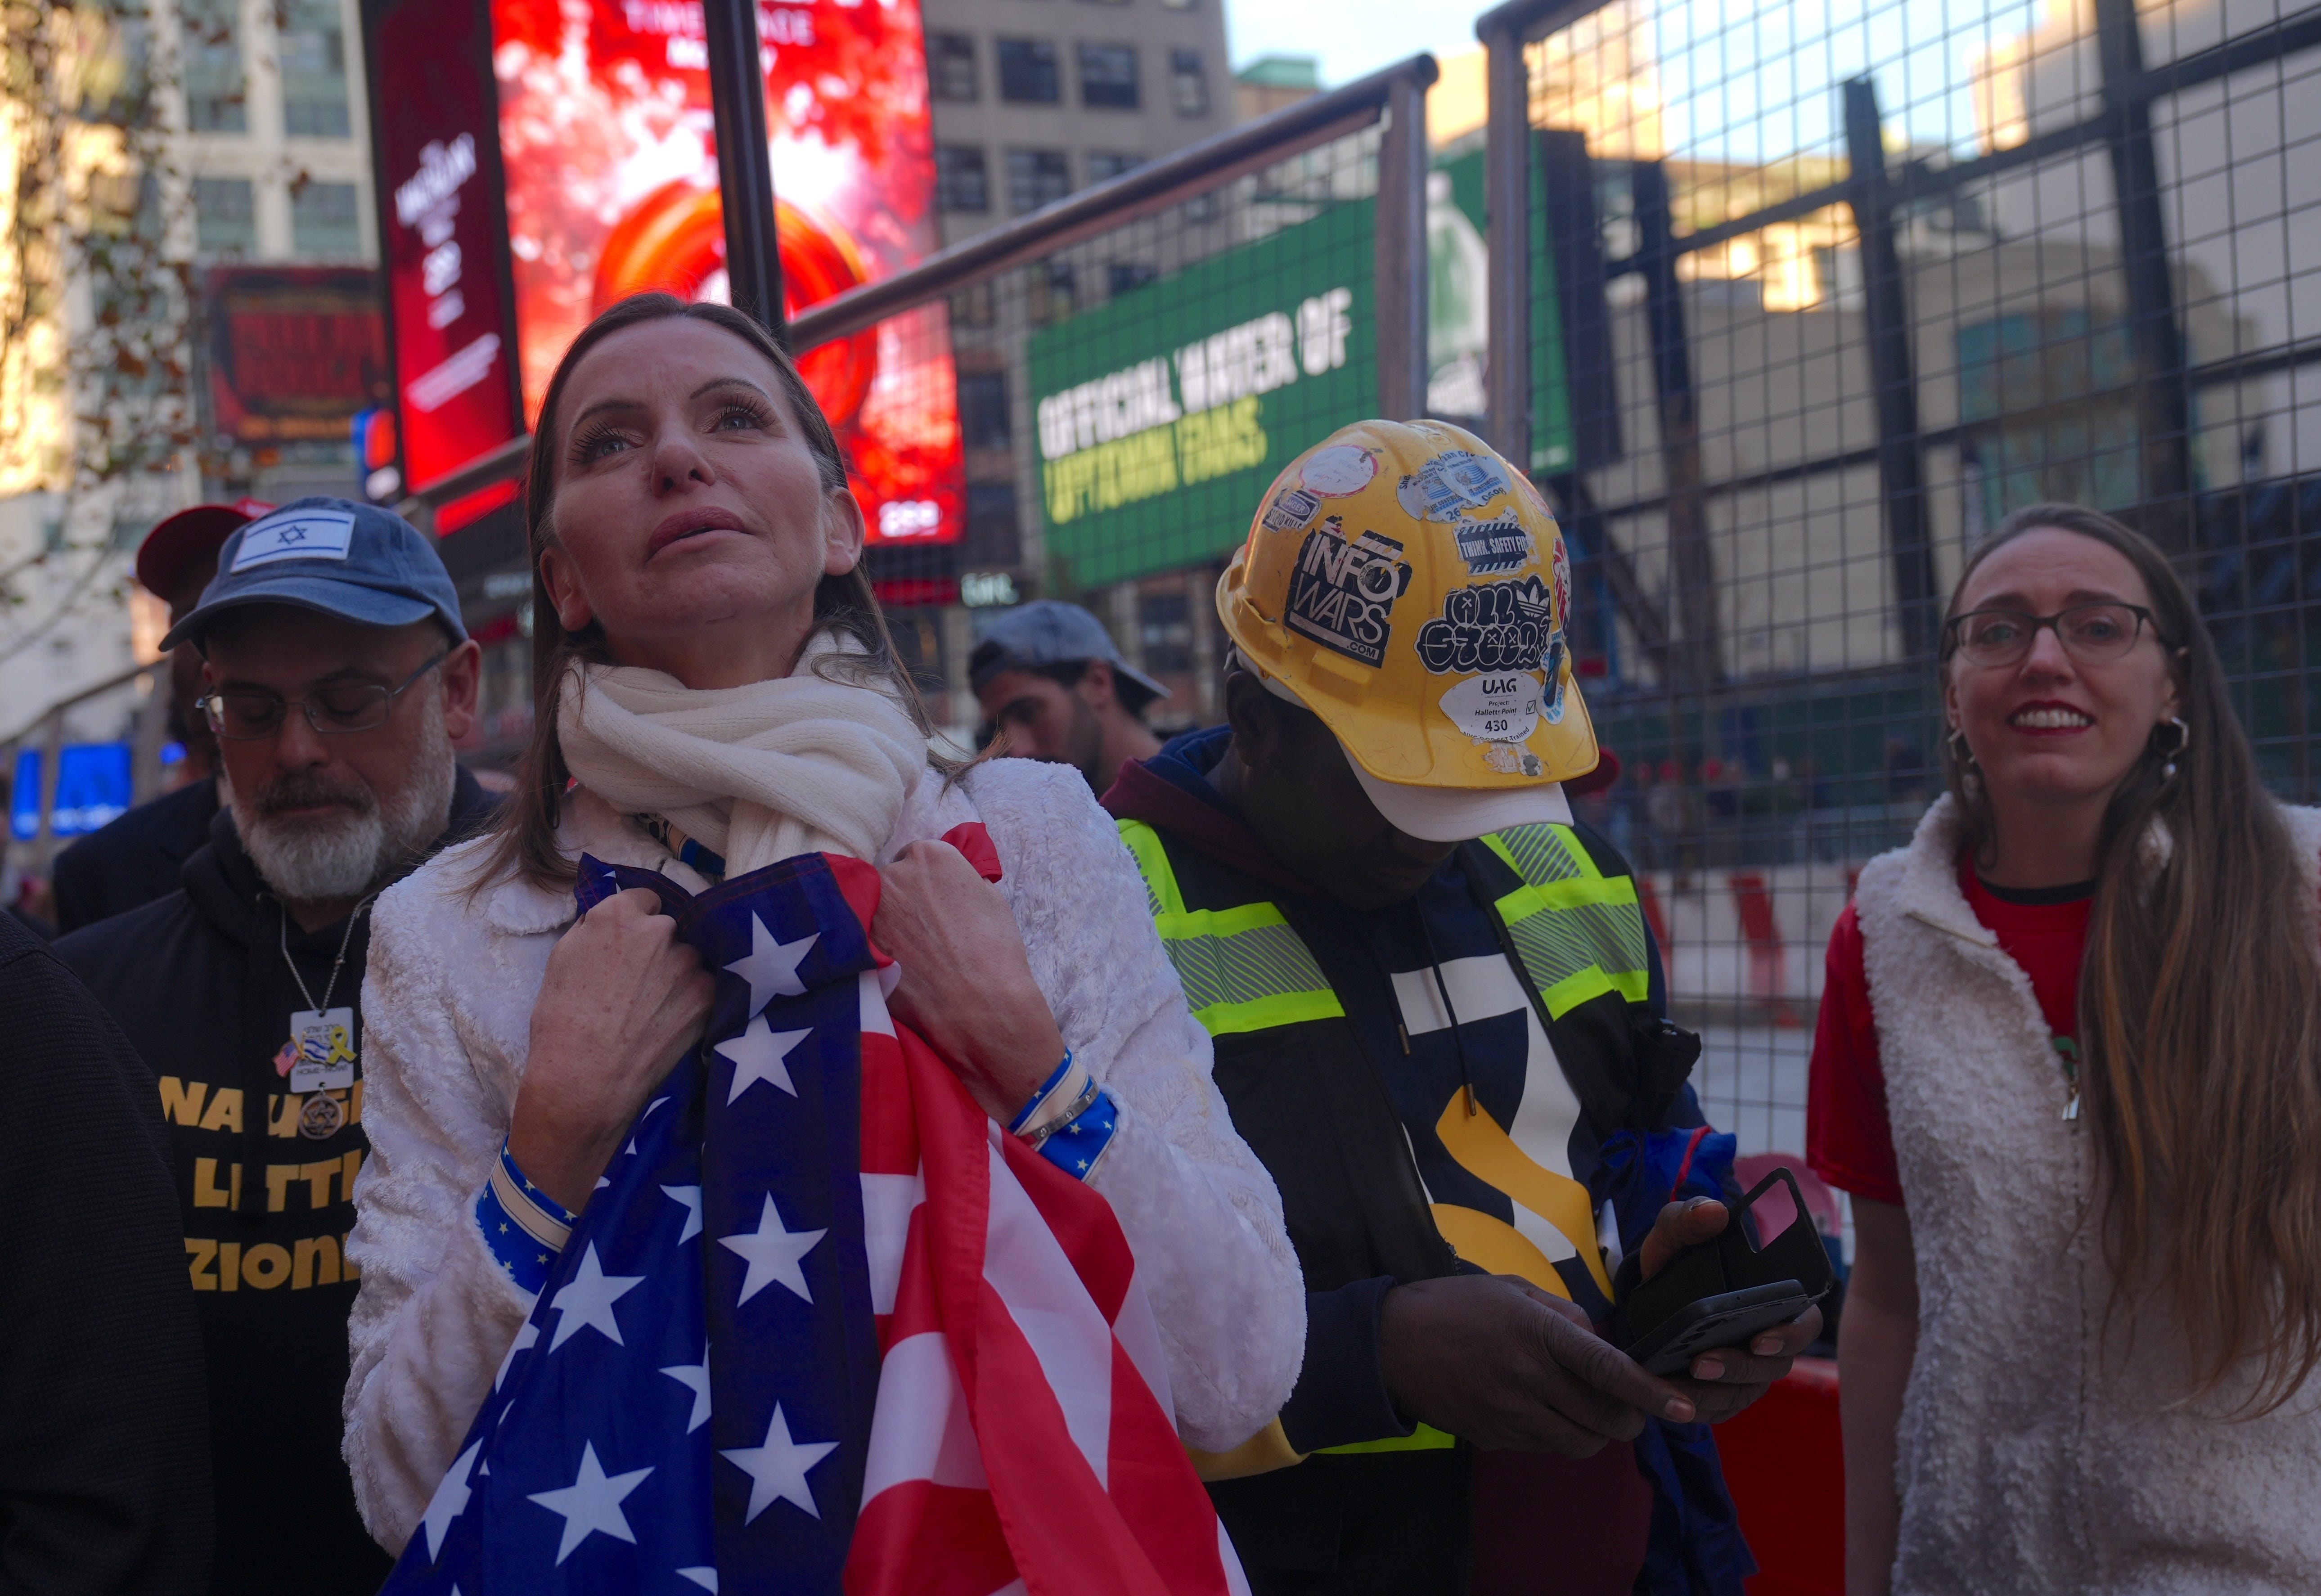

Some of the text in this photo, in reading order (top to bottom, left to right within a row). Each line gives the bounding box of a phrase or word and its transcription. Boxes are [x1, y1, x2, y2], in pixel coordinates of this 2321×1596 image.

[1489, 536, 1516, 554] SAFETY
[1303, 534, 1400, 602] INFO
[1294, 573, 1386, 644] WARS
[1482, 678, 1517, 694] UAG
[1484, 719, 1508, 732] 430
